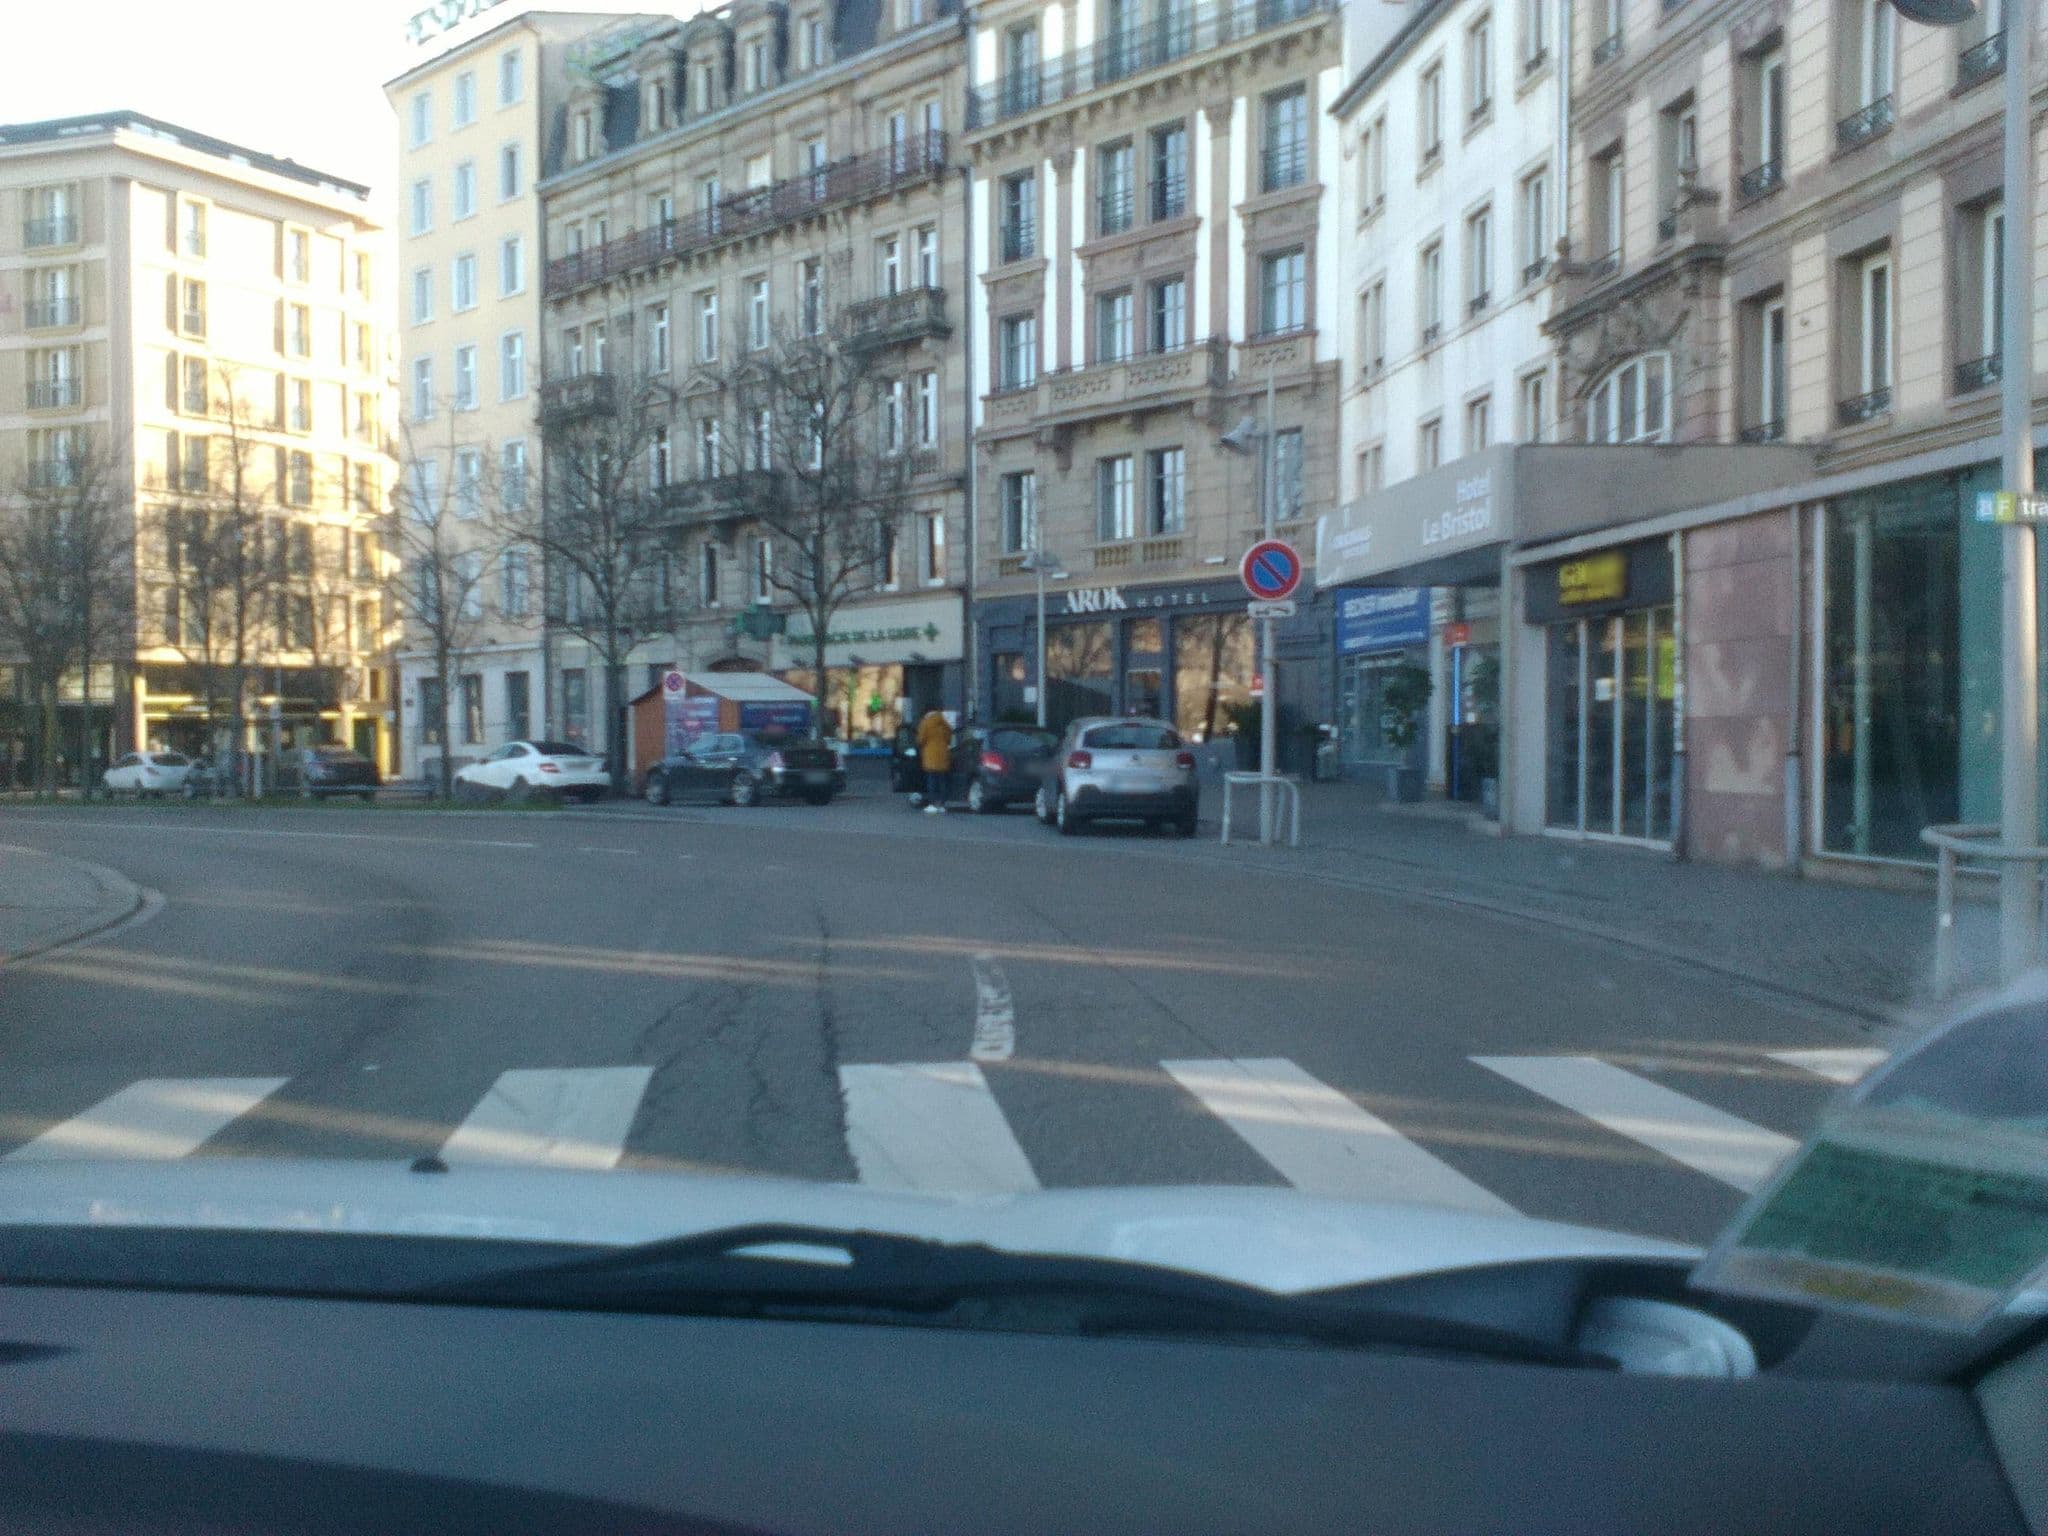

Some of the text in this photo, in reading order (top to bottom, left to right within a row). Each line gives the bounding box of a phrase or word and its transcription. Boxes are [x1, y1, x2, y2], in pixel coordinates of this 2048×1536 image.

[1423, 496, 1492, 545] Le Bristol
[1136, 592, 1210, 608] HOTEL
